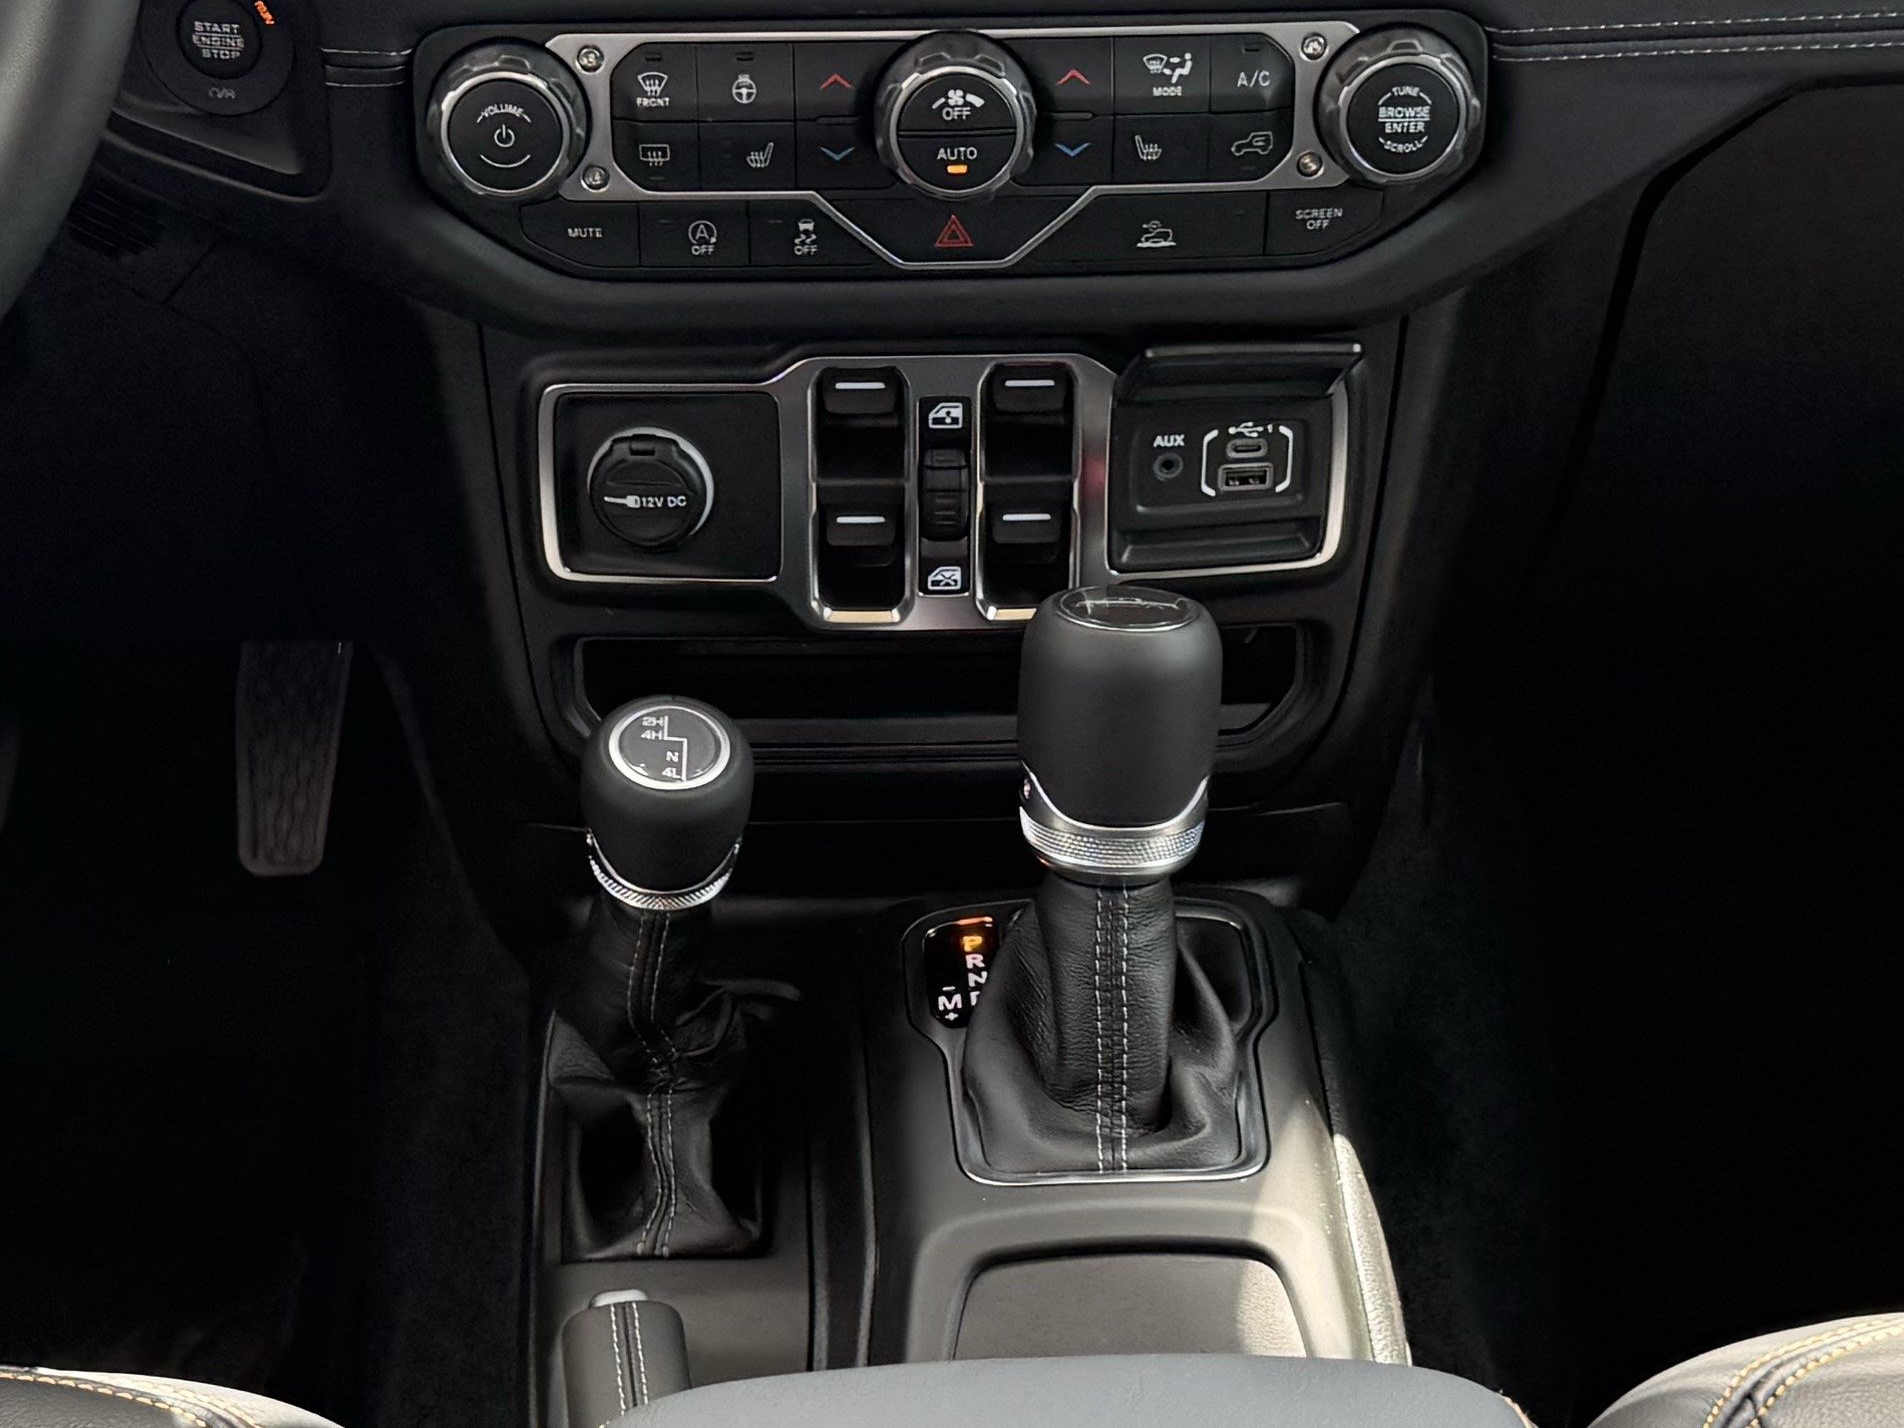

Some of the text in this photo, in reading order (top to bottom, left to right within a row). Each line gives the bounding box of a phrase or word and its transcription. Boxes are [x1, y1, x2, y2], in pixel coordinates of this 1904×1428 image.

[194, 21, 240, 34] START
[192, 34, 245, 48] ENGINE
[201, 48, 241, 59] STOP
[1237, 69, 1272, 88] A/C
[1152, 85, 1183, 97] MODE
[1390, 84, 1421, 98] TUNE
[636, 96, 671, 108] FRONT
[480, 102, 525, 119] VOLUME
[941, 106, 972, 121] OFF
[1377, 105, 1432, 119] BROWSE
[1384, 121, 1426, 134] ENTER
[1383, 139, 1424, 154] SCROLL
[936, 146, 979, 161] AUTO
[1295, 207, 1344, 221] SCREEN
[1305, 218, 1330, 230] OFF
[567, 227, 603, 239] MUTE
[690, 244, 715, 257] OFF
[793, 244, 819, 257] OFF
[1152, 433, 1186, 448] AUX
[641, 495, 688, 508] 12V DC
[641, 716, 664, 728] 2H
[640, 729, 663, 741] 4H
[665, 750, 680, 763] N
[661, 767, 683, 780] 4L
[962, 935, 984, 953] P
[964, 953, 986, 970] R
[967, 971, 989, 988] N
[937, 992, 963, 1012] M
